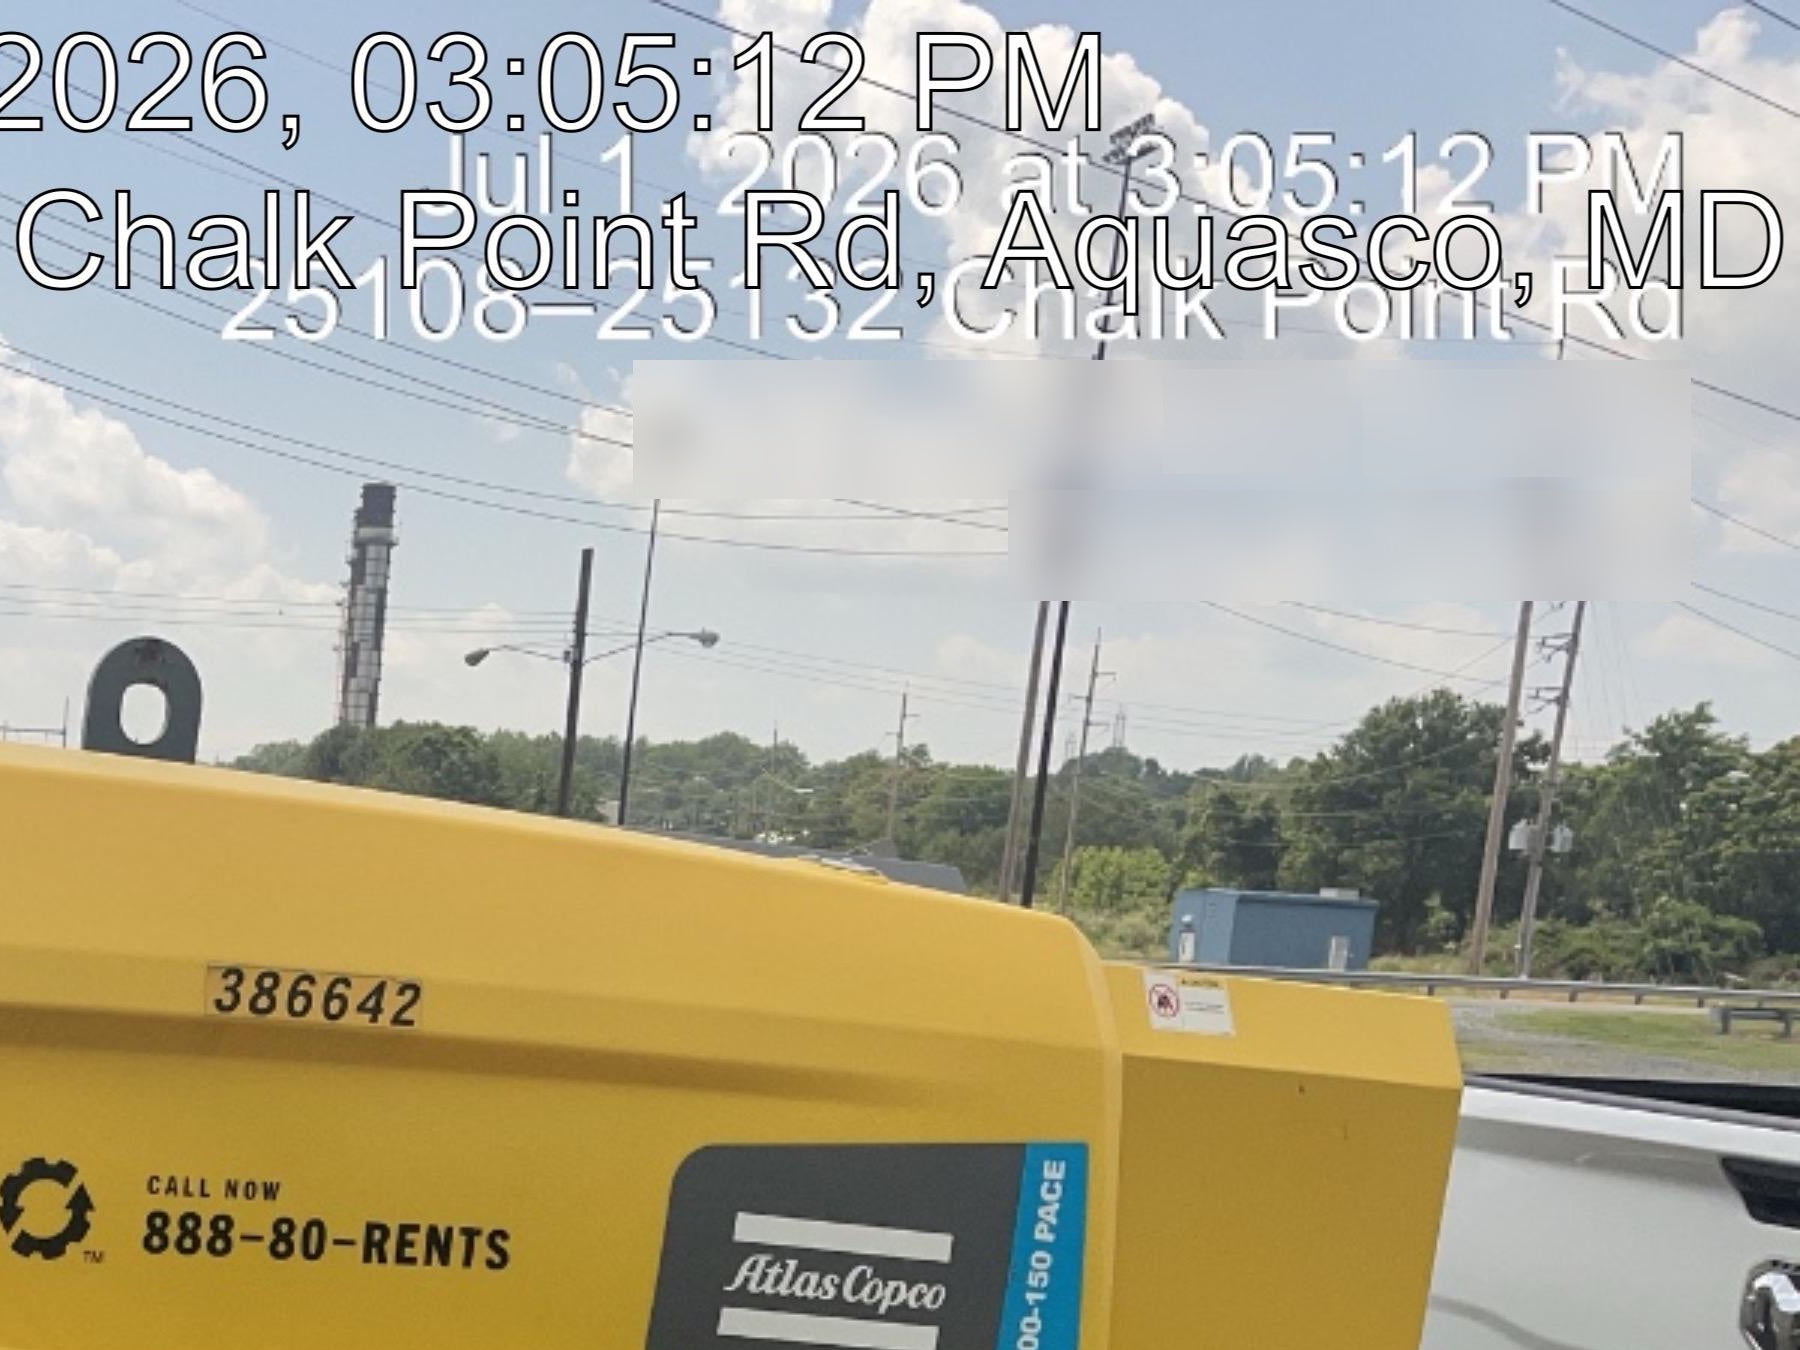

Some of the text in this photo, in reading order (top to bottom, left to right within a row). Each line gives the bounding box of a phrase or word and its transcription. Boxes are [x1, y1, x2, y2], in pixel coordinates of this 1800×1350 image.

[213, 967, 423, 1028] 386642
[147, 1174, 281, 1202] CALL NOW
[1033, 1159, 1066, 1242] PACE
[142, 1210, 511, 1271] 888-80-RENTS
[723, 1253, 947, 1315] Atlas Copco
